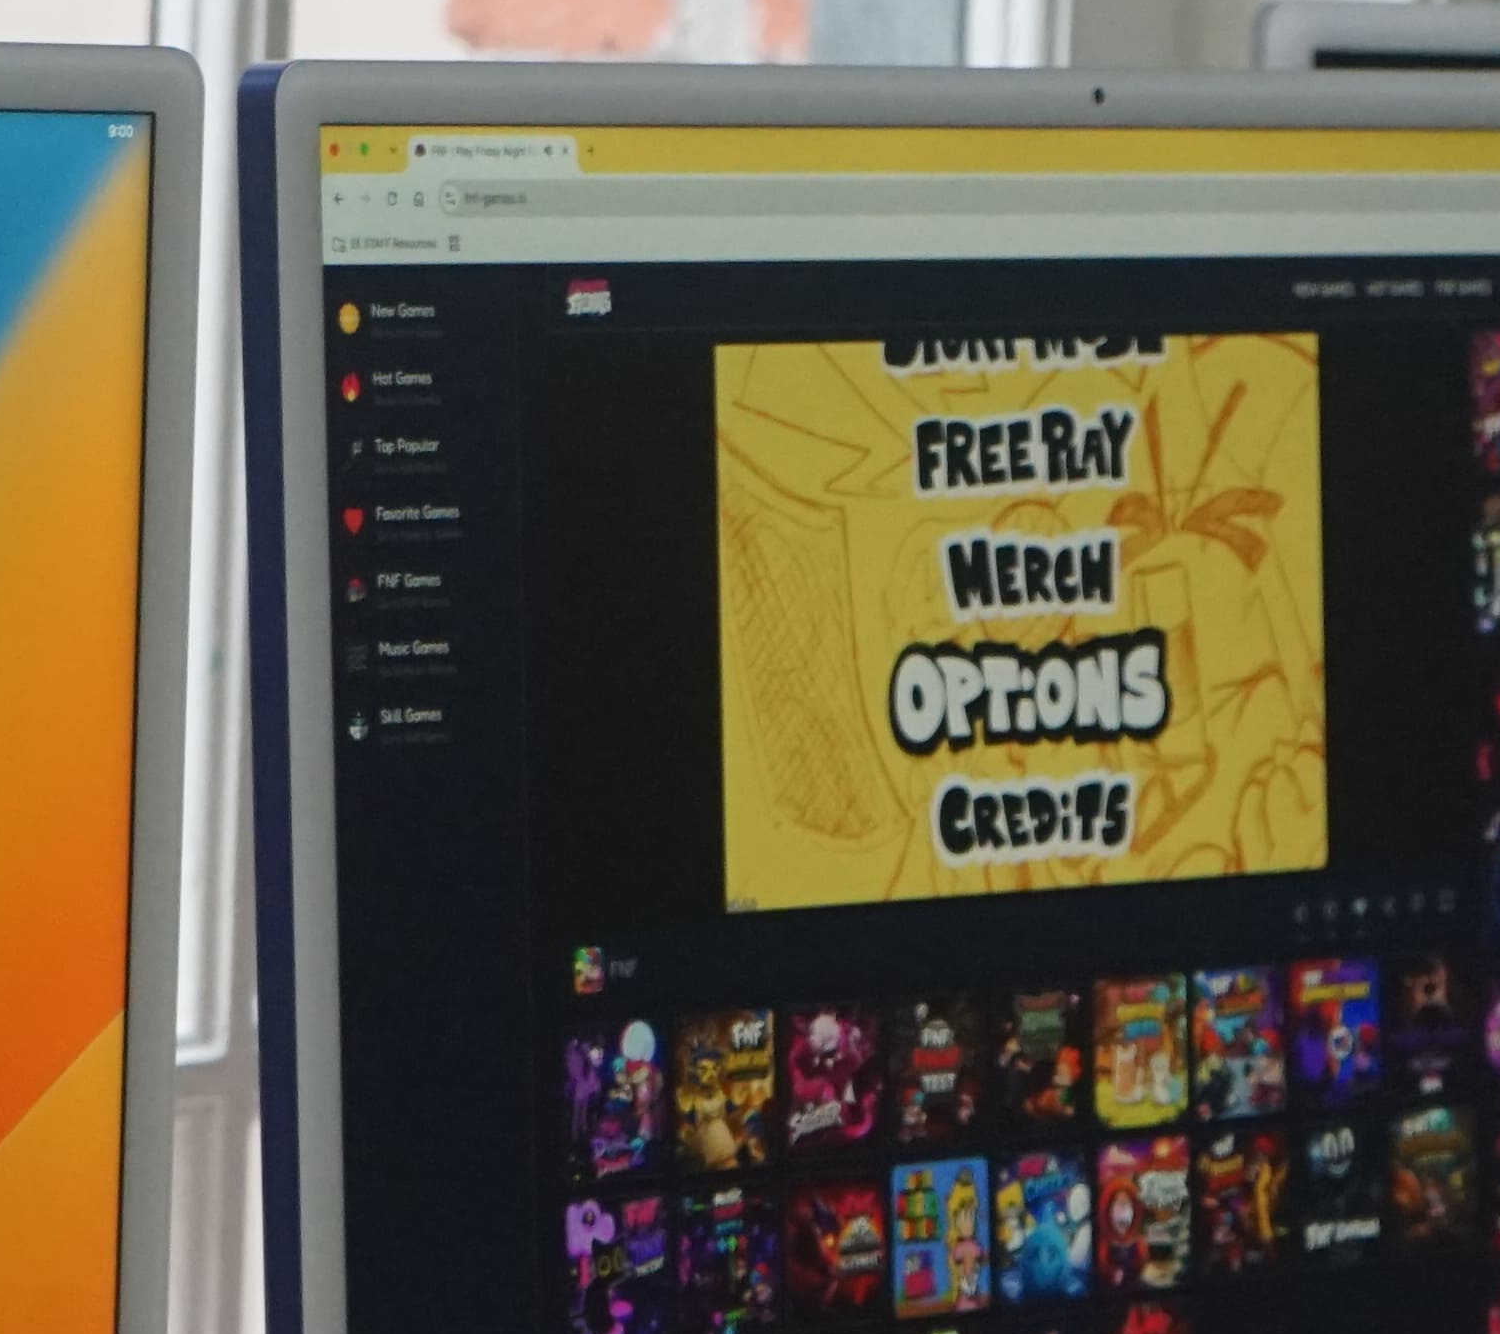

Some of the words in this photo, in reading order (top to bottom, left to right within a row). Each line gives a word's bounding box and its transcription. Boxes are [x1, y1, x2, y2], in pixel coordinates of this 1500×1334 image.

[371, 304, 395, 317] New
[399, 304, 435, 318] Games
[373, 372, 393, 386] Hot
[396, 371, 432, 385] Games
[375, 439, 395, 454] Top
[397, 438, 440, 454] Popular
[376, 506, 420, 521] Favorite
[423, 505, 460, 519] Games
[377, 574, 402, 588] FNF
[404, 573, 441, 588] Games
[949, 540, 1112, 608] MERCH
[379, 641, 410, 656] Music
[413, 640, 449, 655] Games
[381, 709, 402, 724] Skill
[405, 708, 442, 722] Games
[731, 1021, 764, 1049] FNF
